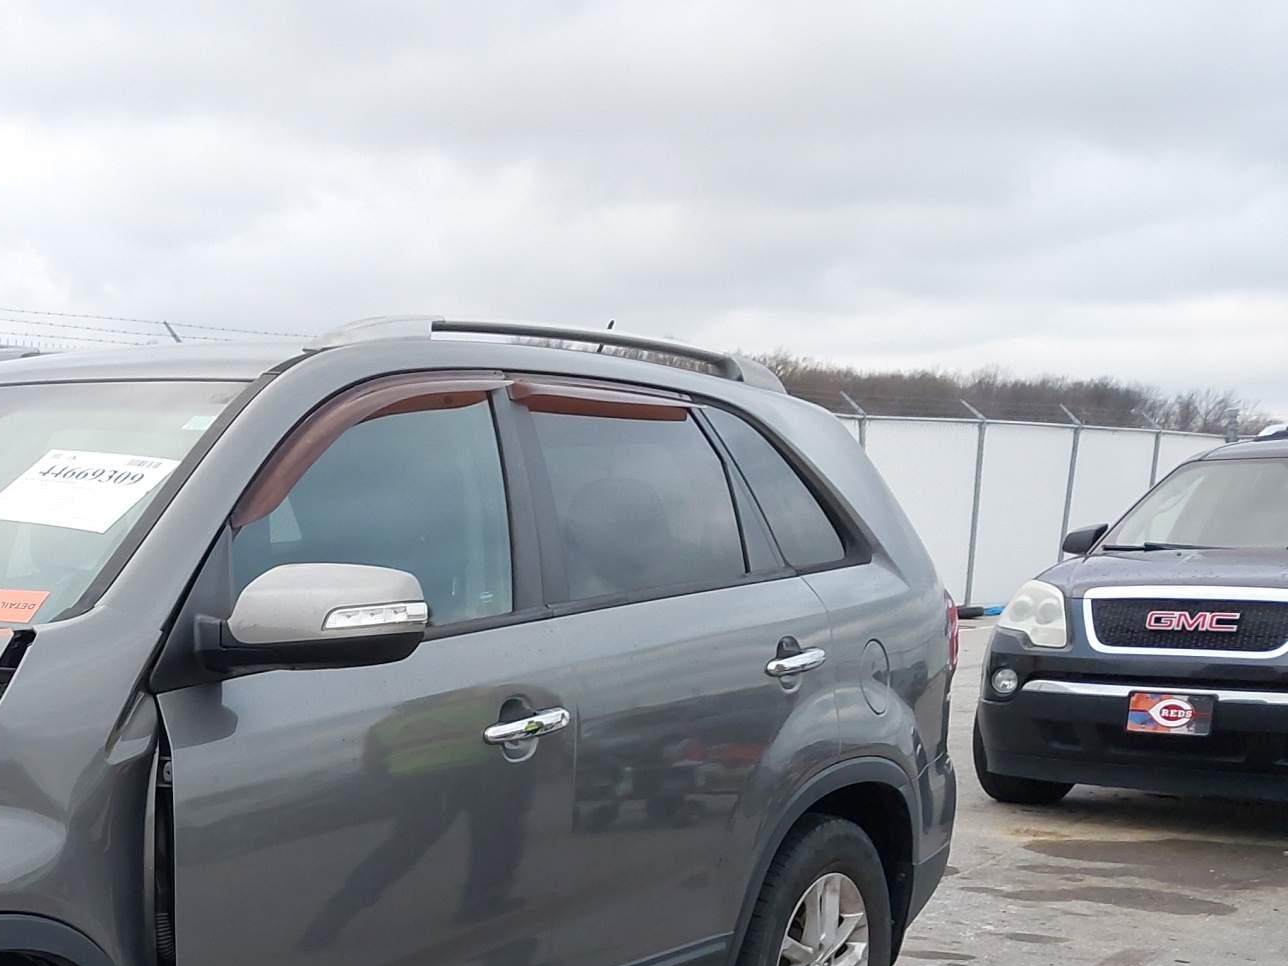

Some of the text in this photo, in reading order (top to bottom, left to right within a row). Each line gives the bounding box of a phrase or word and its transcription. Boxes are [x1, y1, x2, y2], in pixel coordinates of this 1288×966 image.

[39, 465, 144, 485] 44669309
[1145, 610, 1241, 632] GMC
[1160, 708, 1193, 718] REDS
